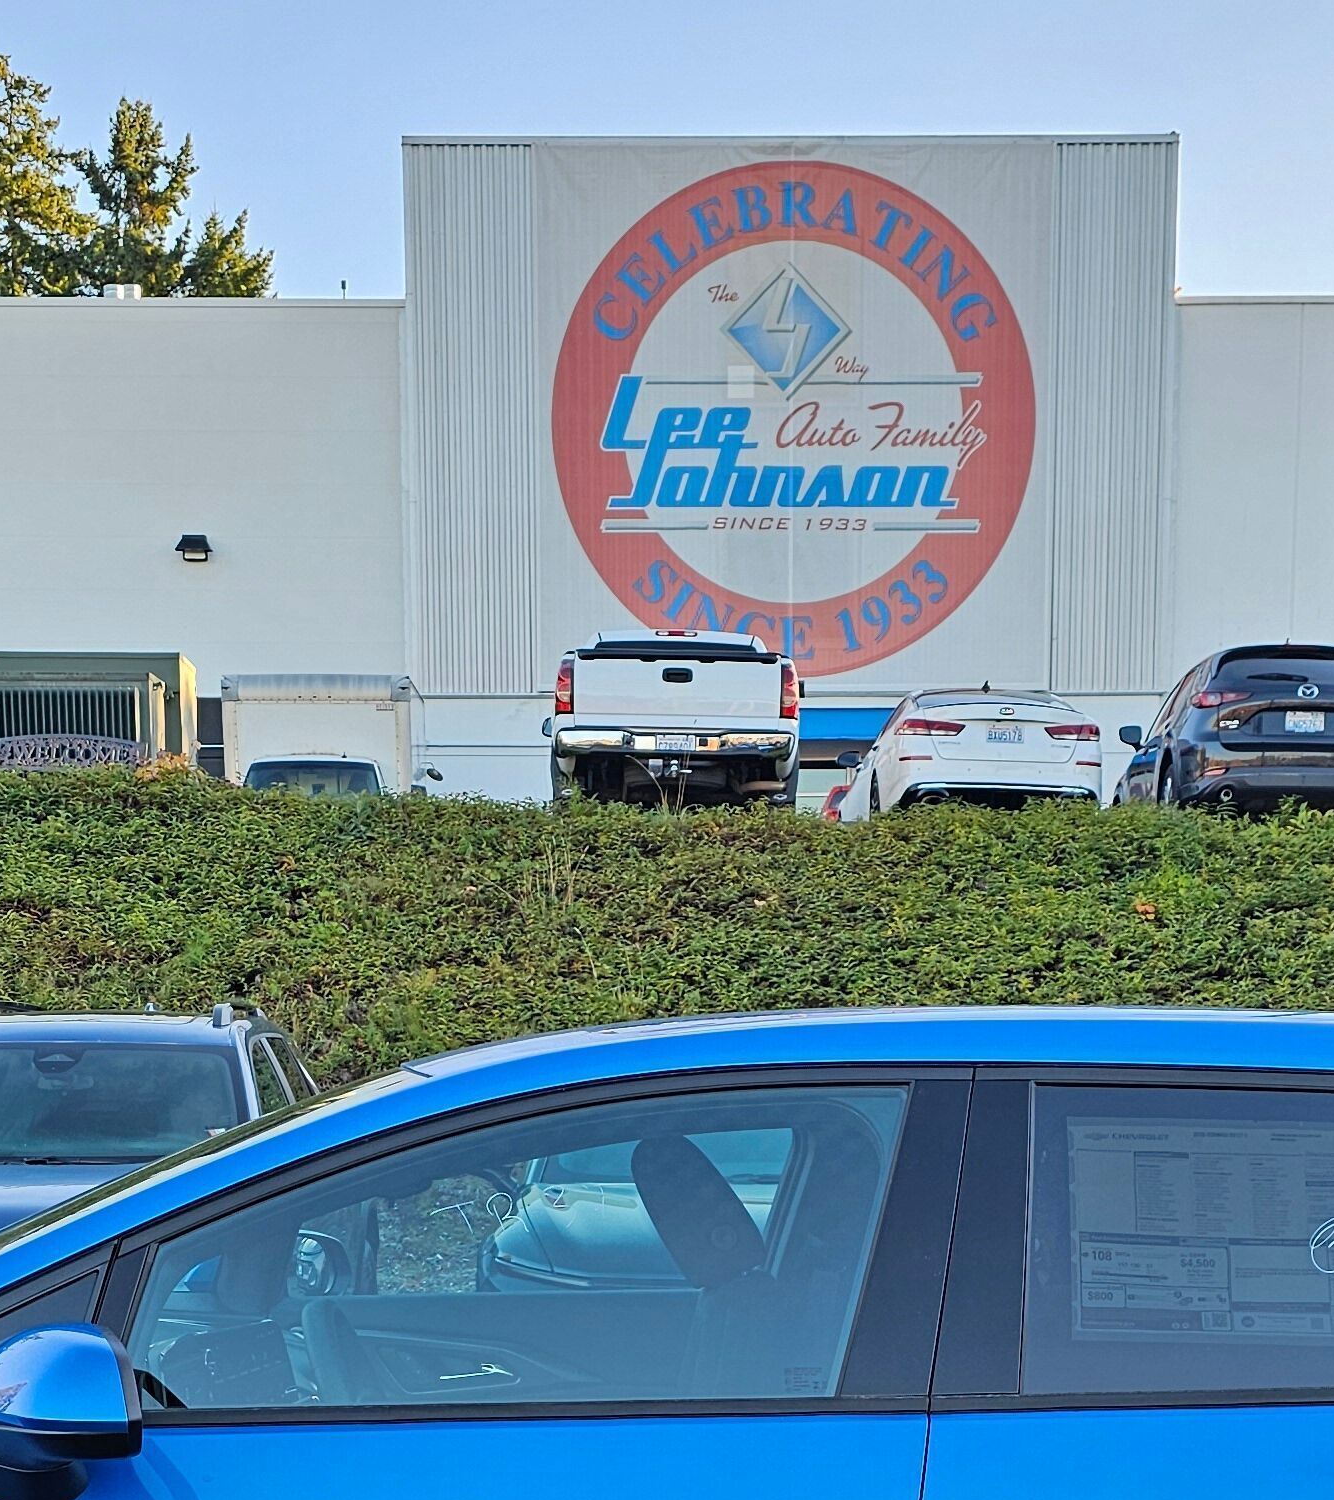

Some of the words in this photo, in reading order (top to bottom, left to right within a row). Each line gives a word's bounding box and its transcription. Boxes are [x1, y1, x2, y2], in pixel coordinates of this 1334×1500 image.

[592, 181, 998, 342] CELEBRATING
[707, 284, 740, 304] The
[834, 356, 869, 382] Way
[602, 375, 758, 449] Lee
[776, 401, 862, 449] Auto
[868, 400, 987, 468] Family
[608, 434, 958, 508] Johnson
[712, 516, 793, 532] SINCE
[804, 517, 868, 532] 1933
[834, 559, 949, 653] 1933
[12, 744, 131, 764] WELCOME
[1111, 1132, 1170, 1142] CHEVROLET
[1092, 1250, 1113, 1262] 108
[1179, 1258, 1217, 1269] $4,500
[1087, 1290, 1114, 1302] $800
